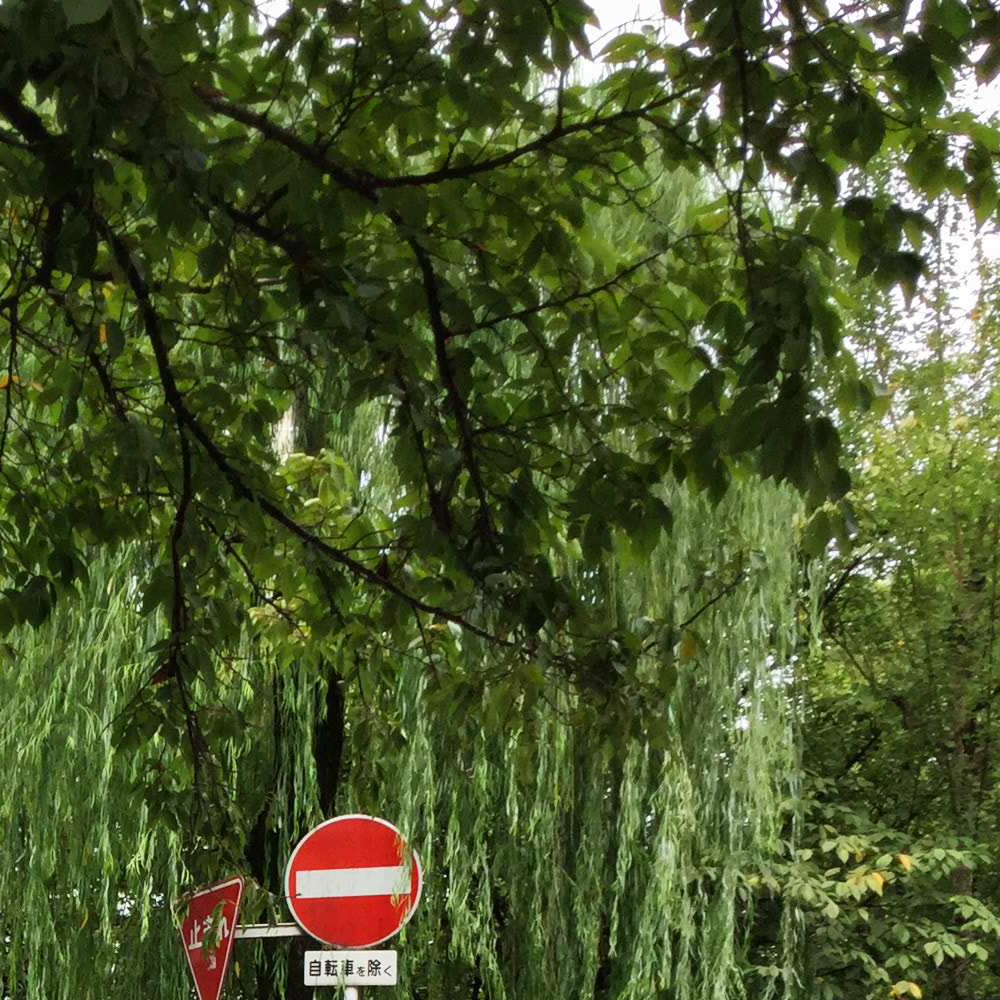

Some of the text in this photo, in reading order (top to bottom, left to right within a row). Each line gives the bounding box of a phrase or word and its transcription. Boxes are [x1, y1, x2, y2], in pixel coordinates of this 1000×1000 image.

[309, 958, 392, 977] 自転車を除く
